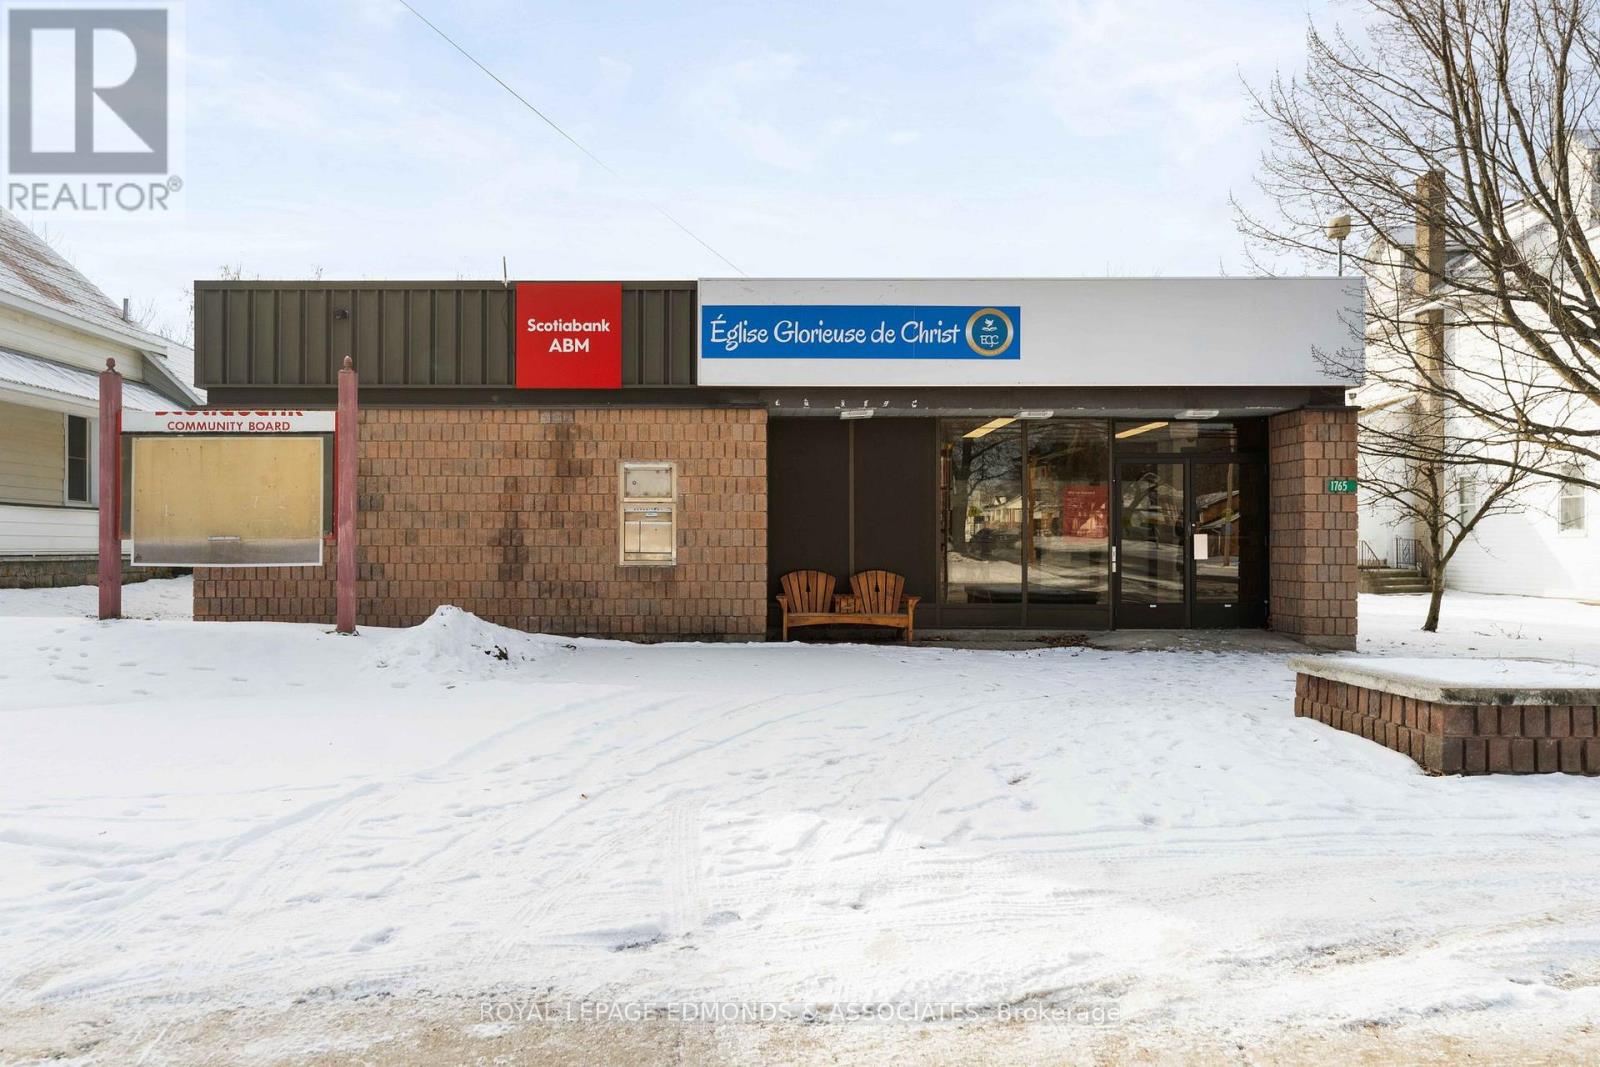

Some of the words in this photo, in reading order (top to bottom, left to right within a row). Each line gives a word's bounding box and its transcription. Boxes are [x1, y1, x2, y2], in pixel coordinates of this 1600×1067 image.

[527, 318, 610, 332] Scotiabank
[710, 313, 769, 351] Église
[773, 319, 866, 344] Glorieuse
[870, 320, 896, 344] de
[900, 319, 961, 344] Christ
[548, 338, 590, 353] ABM
[167, 421, 244, 431] COMMUNITY
[248, 421, 291, 431] BOARD
[1330, 480, 1348, 491] 1765
